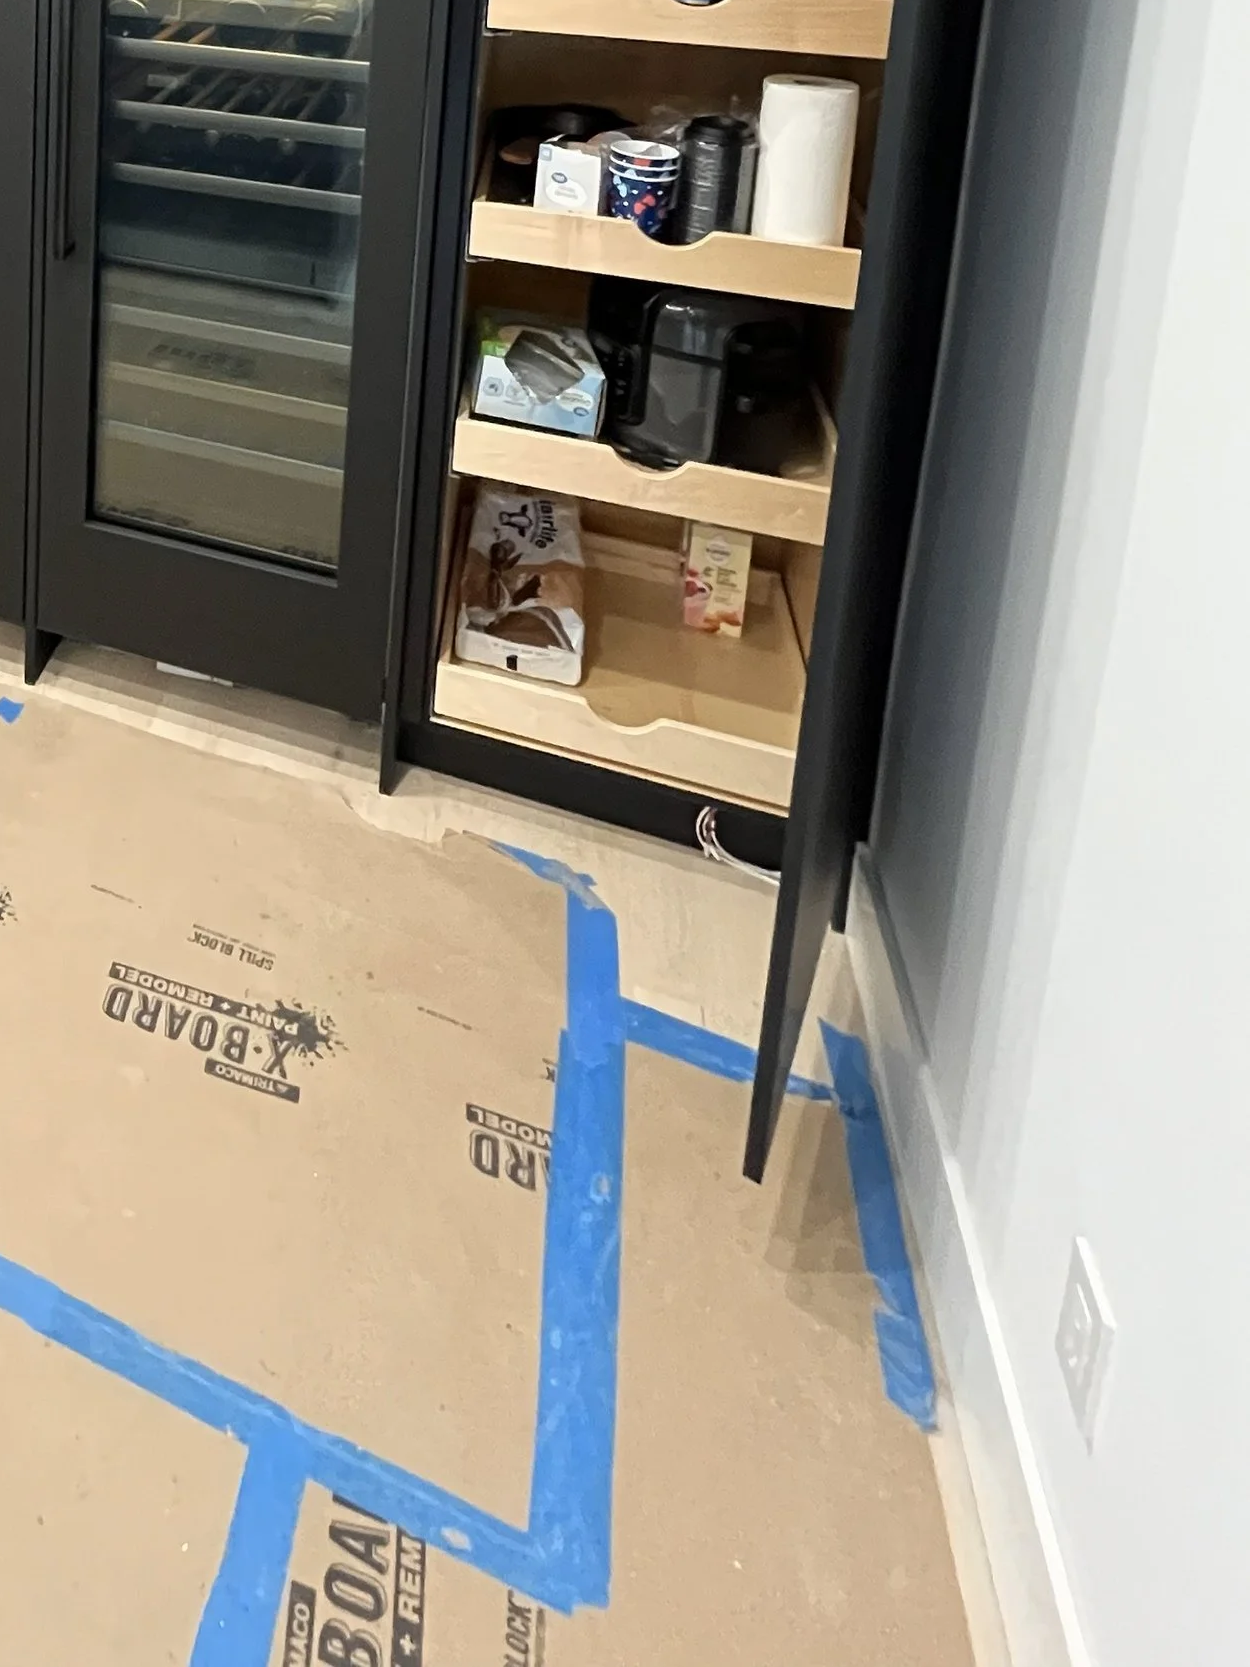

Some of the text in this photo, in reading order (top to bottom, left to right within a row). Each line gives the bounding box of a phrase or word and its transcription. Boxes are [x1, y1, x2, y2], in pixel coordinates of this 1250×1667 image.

[193, 931, 234, 957] BLOCK
[239, 948, 274, 972] SPILL
[115, 965, 214, 1007] REMODEL
[236, 1005, 299, 1035] PAINT
[215, 1064, 275, 1092] TRIMACO
[470, 1106, 552, 1147] MODEL
